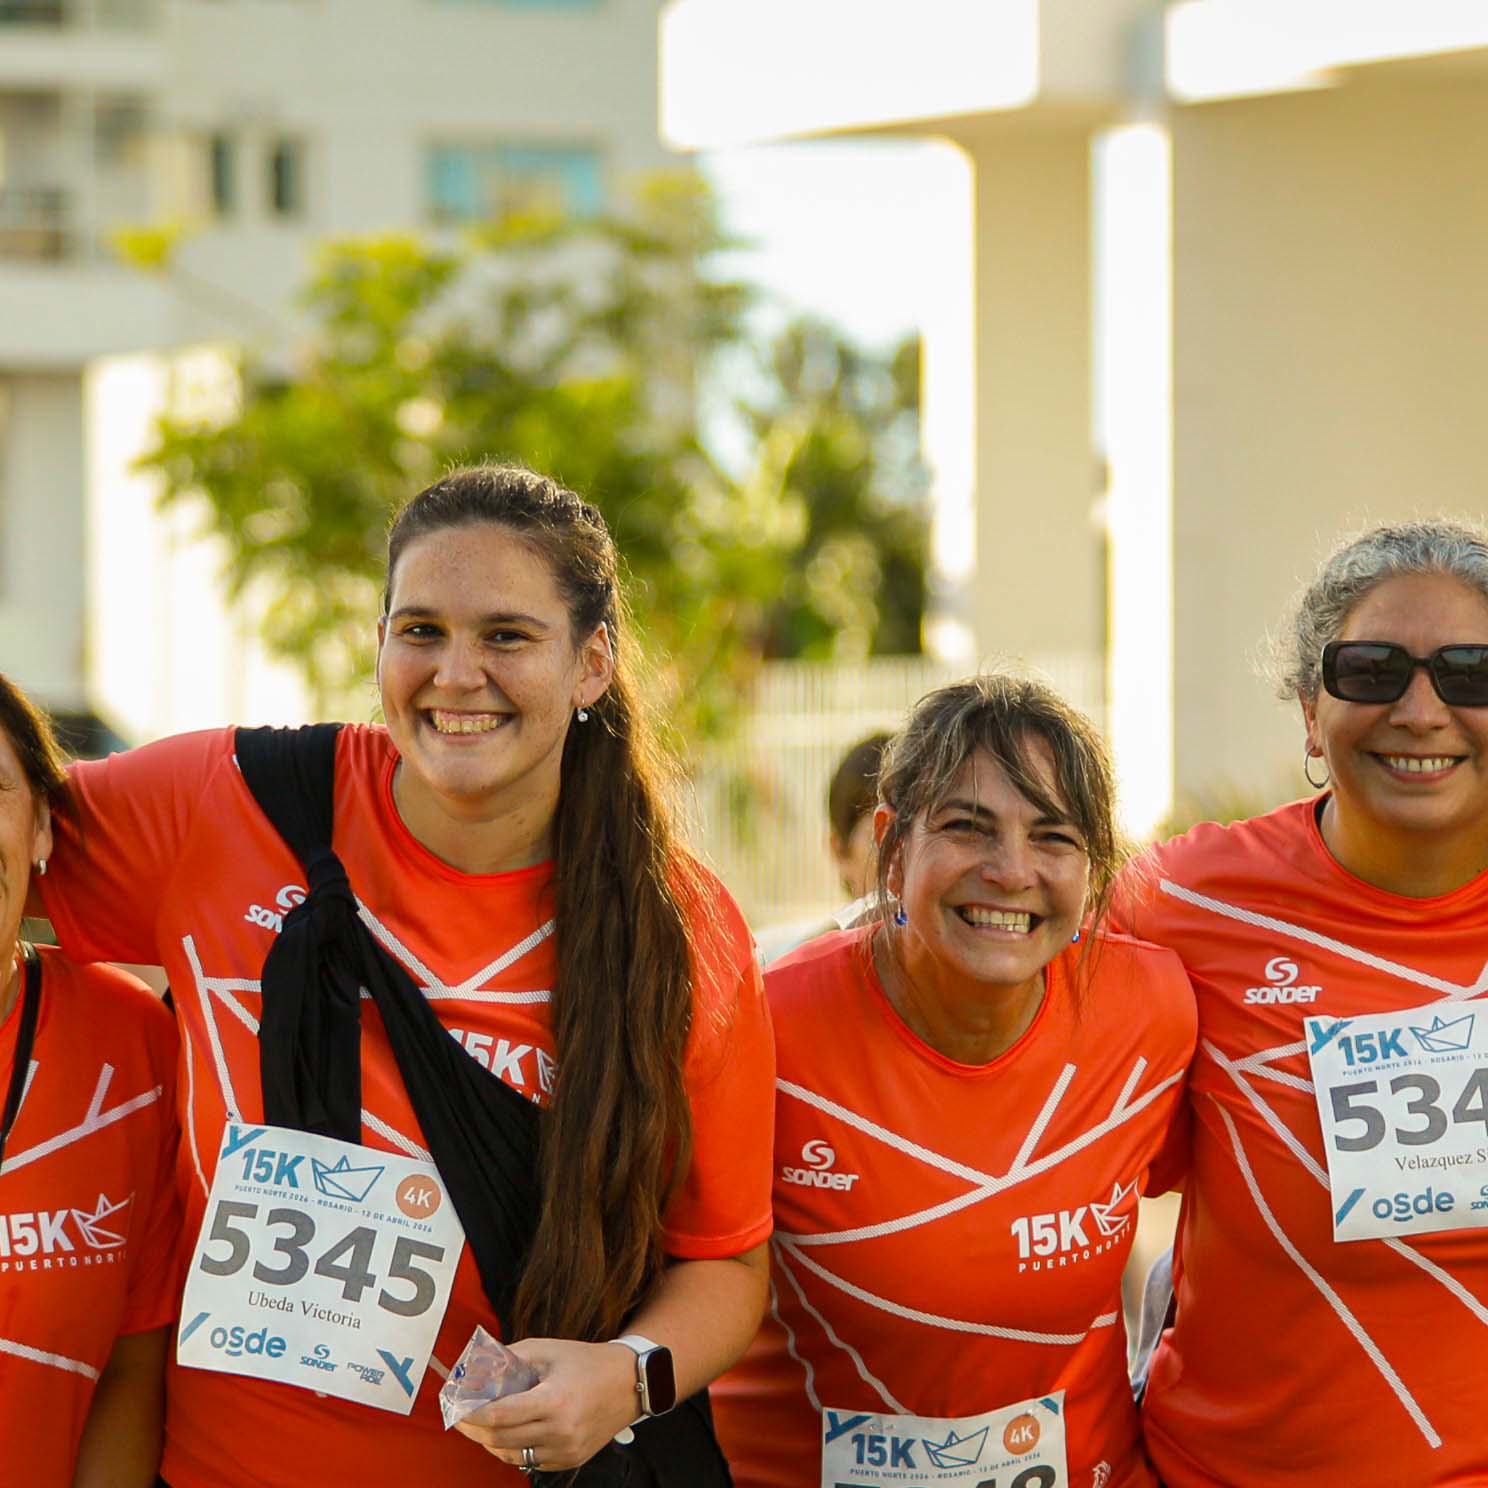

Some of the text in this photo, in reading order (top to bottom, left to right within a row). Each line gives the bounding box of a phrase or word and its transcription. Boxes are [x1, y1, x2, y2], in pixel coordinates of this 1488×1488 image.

[244, 904, 282, 933] SON
[1338, 1027, 1409, 1066] 15K
[242, 1148, 305, 1188] 15K
[1395, 1151, 1473, 1172] Velazquez
[263, 1189, 287, 1199] NORTE
[317, 1199, 353, 1213] ROSARIO
[373, 1212, 384, 1220] DE
[403, 1186, 432, 1208] 4K
[1372, 1185, 1455, 1222] osde
[1011, 1206, 1090, 1259] 15K
[1, 1257, 77, 1272] PUERTO
[200, 1200, 445, 1317] 5345
[1019, 1250, 1090, 1273] PUERTO
[248, 1291, 361, 1330] Ubeda Victoria
[210, 1326, 287, 1357] osde
[1009, 1424, 1034, 1445] 4K
[851, 1433, 917, 1469] 15K
